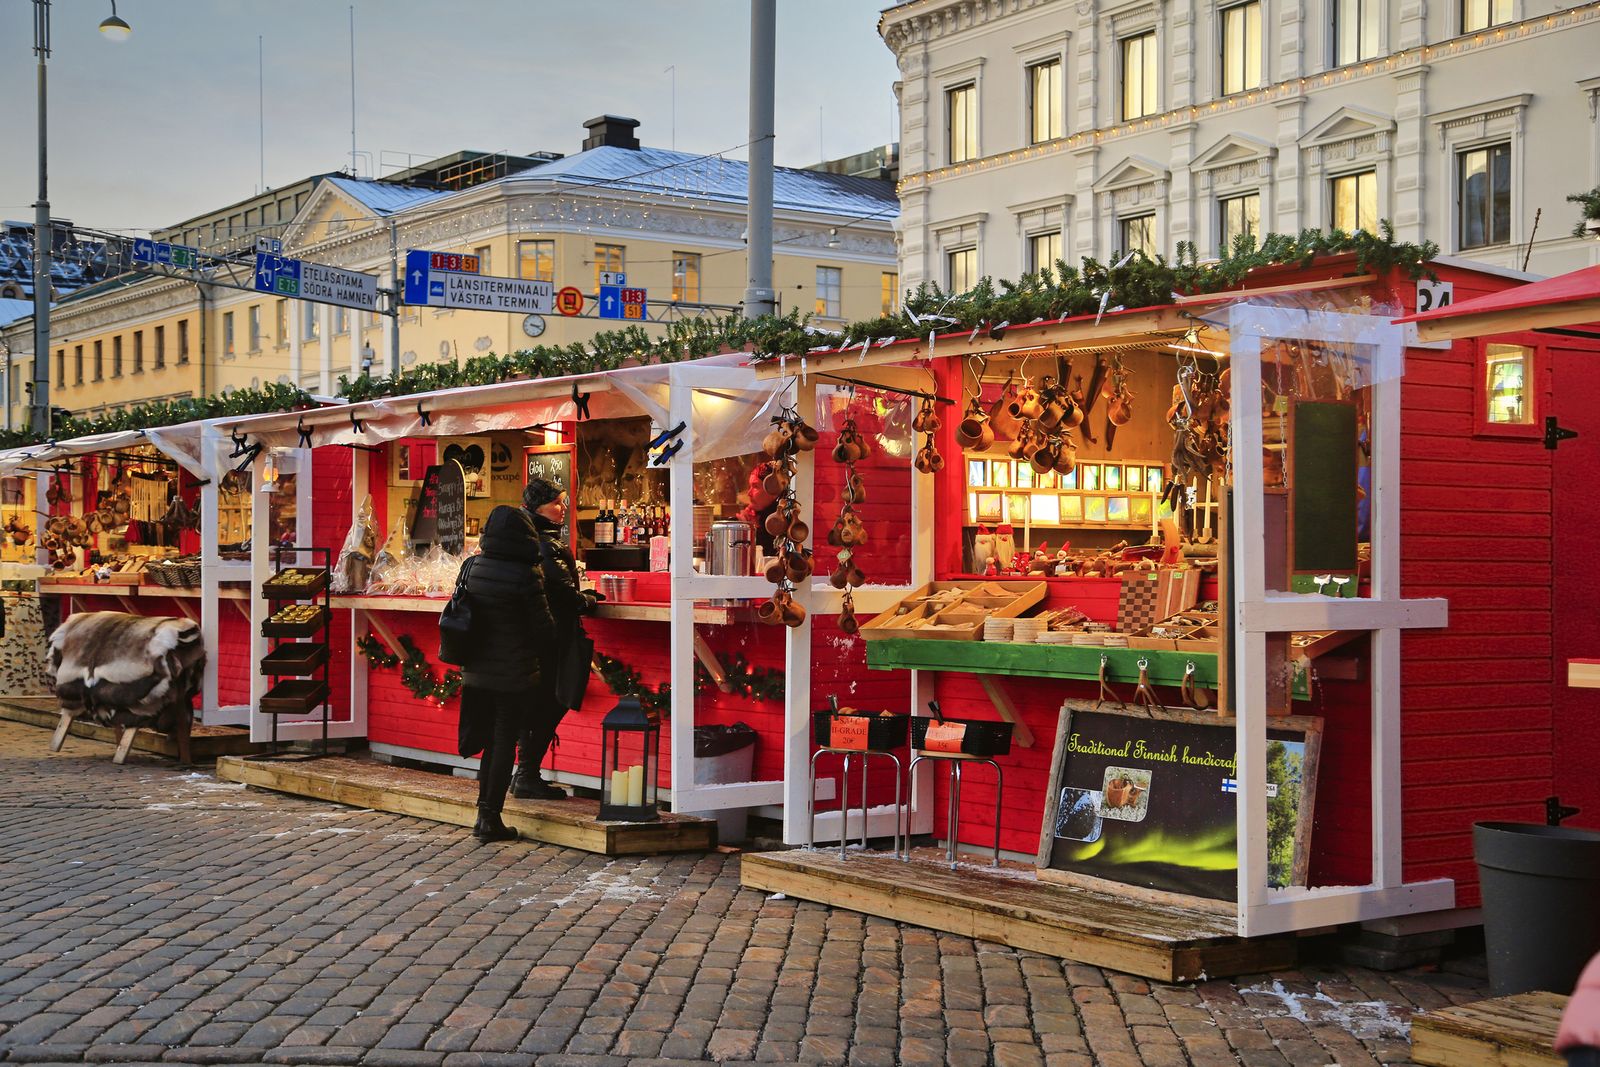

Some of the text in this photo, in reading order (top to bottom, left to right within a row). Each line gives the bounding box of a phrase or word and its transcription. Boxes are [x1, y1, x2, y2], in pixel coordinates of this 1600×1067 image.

[436, 255, 475, 269] 1 3 51
[303, 267, 363, 289] ETELÄSATAMA
[450, 276, 548, 297] LÄNSITERMINAALI
[617, 274, 624, 284] P
[303, 281, 373, 305] SÖDRA HAMNEN
[450, 291, 542, 310] VÄSTRA TERMIN.
[636, 291, 642, 302] 3
[628, 305, 638, 316] 51
[1067, 733, 1131, 758] Traditional
[1133, 739, 1178, 763] Finnish
